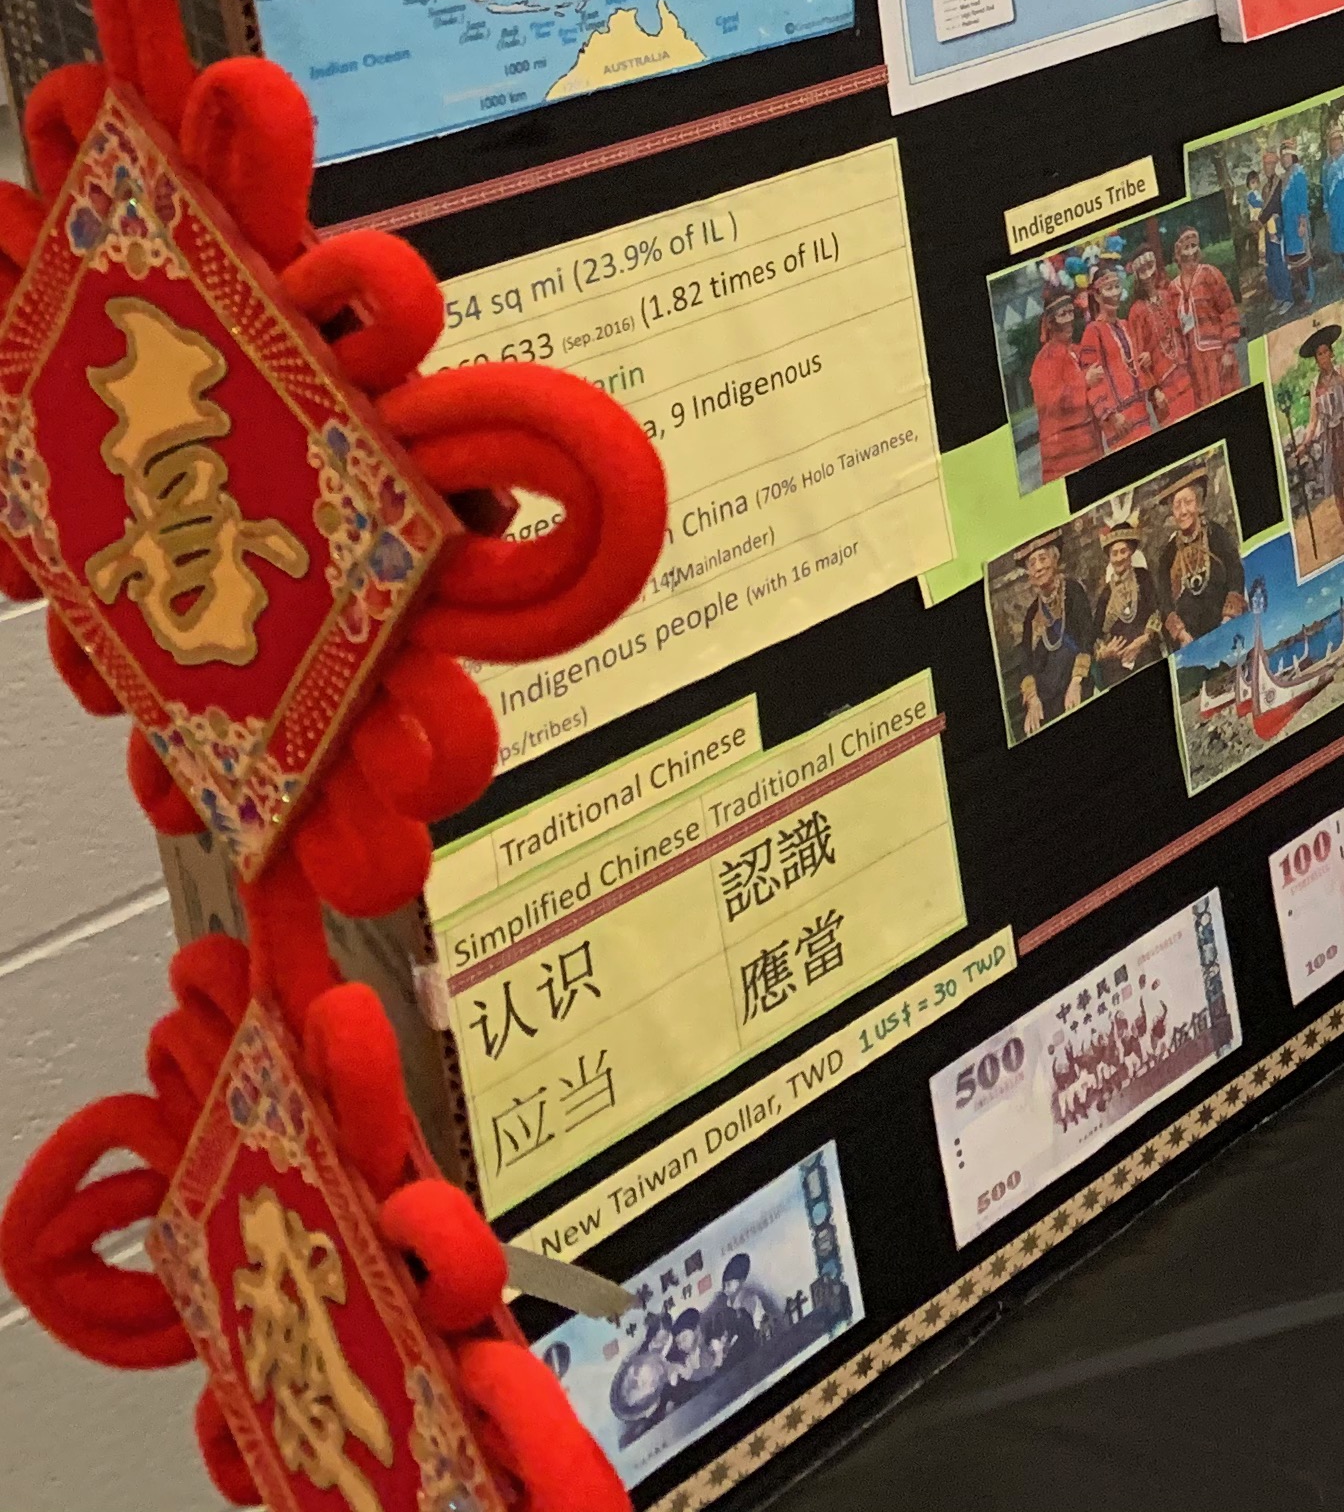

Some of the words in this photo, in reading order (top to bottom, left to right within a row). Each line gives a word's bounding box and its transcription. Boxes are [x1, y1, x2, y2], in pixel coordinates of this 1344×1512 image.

[603, 49, 671, 76] AUSTRALIA
[1012, 191, 1103, 244] Indigenous
[1105, 175, 1147, 207] Tribe
[490, 291, 524, 316] sq
[531, 267, 565, 304] mi
[573, 236, 662, 295] (23.9%
[668, 225, 696, 257] of
[701, 217, 725, 246] IL
[561, 315, 636, 355] (Sep.2016)
[640, 281, 705, 330] (1.82
[710, 258, 777, 300] times
[783, 244, 807, 273] of
[811, 231, 840, 263] IL)
[671, 402, 686, 429] 9
[693, 351, 823, 420] Indigenous
[682, 494, 749, 540] China
[755, 474, 798, 512] (70%
[802, 462, 835, 492] Holo
[838, 427, 920, 475] Taiwanese,
[500, 632, 648, 716] Indigenous
[655, 593, 740, 652] people
[745, 569, 788, 607] (with
[791, 562, 812, 583] 16
[815, 539, 860, 579] major
[500, 705, 589, 766] ps/tribes)
[454, 865, 593, 969] Simplified
[599, 818, 701, 886] Chinese
[708, 752, 837, 830] Traditional
[842, 696, 928, 758] Chinese
[500, 780, 643, 871] Traditional
[648, 724, 747, 800] Chinese
[1278, 830, 1332, 889] 100
[469, 941, 602, 1061] 认识
[718, 811, 838, 924] 認識
[1305, 944, 1338, 977] 100
[493, 1048, 617, 1178] 应当
[741, 908, 845, 1027] 應當
[955, 1037, 1025, 1110] 500
[541, 1204, 602, 1257] New
[606, 1145, 699, 1218] Taiwan
[704, 1095, 784, 1157] Dollar,
[785, 1047, 845, 1102] TWD
[933, 978, 959, 1008] 30
[962, 943, 1007, 985] TWD
[976, 1169, 1022, 1215] 500
